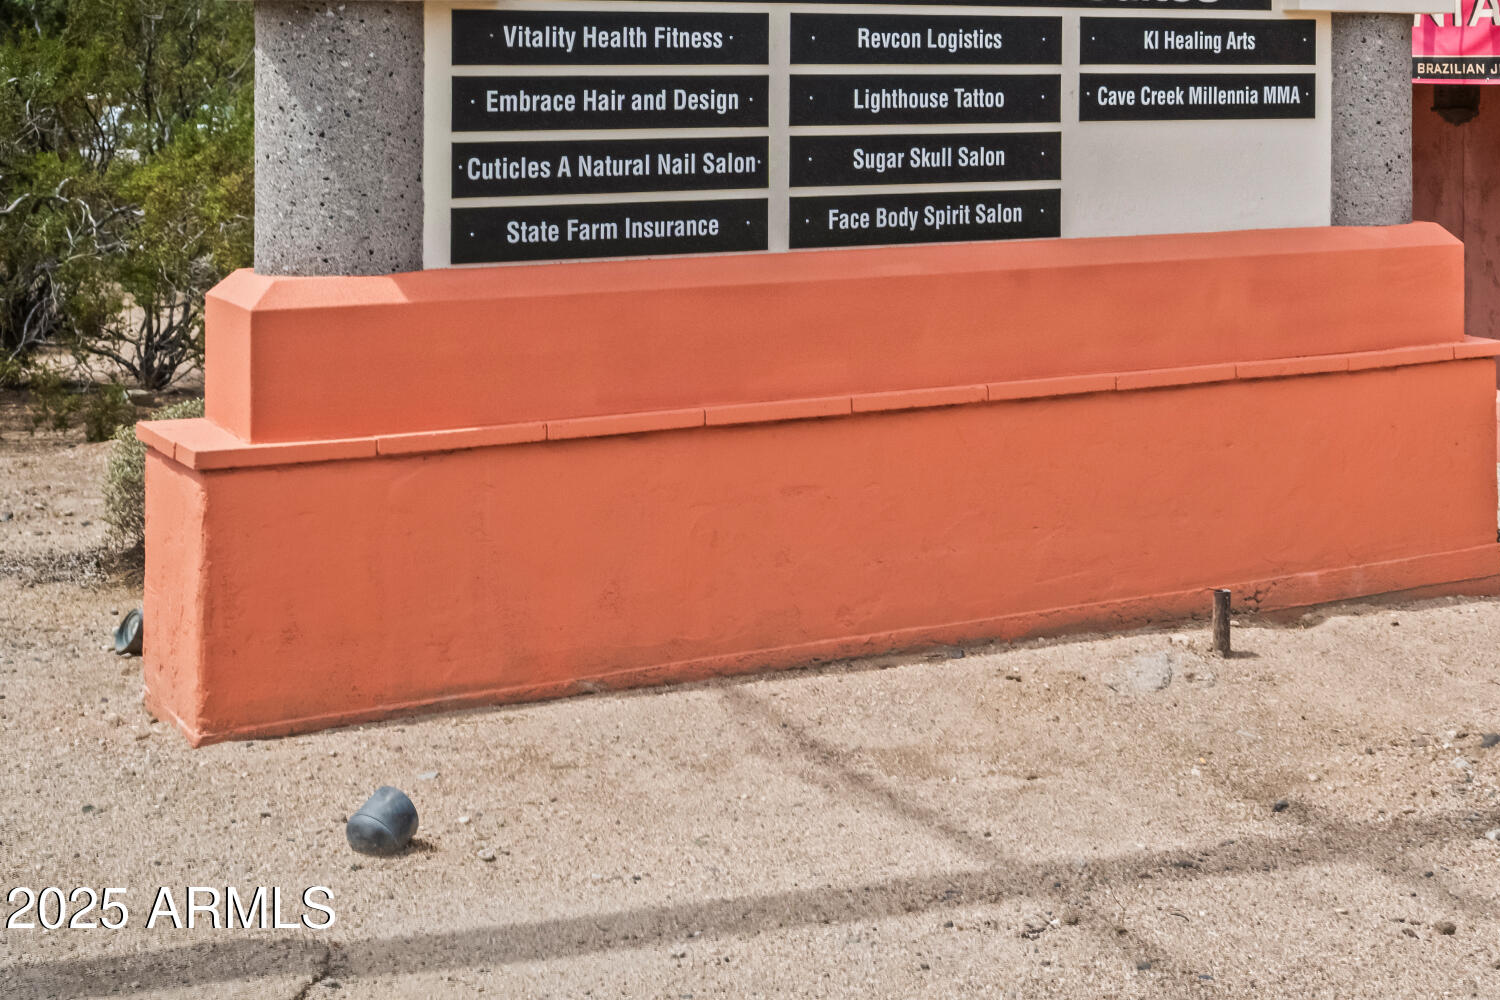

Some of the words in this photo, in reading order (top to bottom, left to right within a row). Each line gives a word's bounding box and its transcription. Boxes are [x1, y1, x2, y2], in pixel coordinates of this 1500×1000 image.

[503, 25, 577, 53] Vitality
[583, 26, 647, 49] Health
[654, 26, 723, 50] Fitness
[857, 27, 921, 49] Revcon
[927, 28, 1002, 54] Logistics
[1164, 30, 1222, 55] Healing
[1225, 31, 1257, 51] Arts
[1417, 62, 1485, 74] BRAZILIAN
[486, 89, 576, 113] Embrace
[583, 89, 626, 111] Hair
[631, 89, 667, 112] and
[673, 88, 739, 116] Design
[853, 88, 949, 114] Lighthouse
[953, 87, 1005, 109] Tattoo
[1097, 86, 1136, 107] Cave
[1140, 85, 1185, 106] Creek
[1188, 85, 1259, 106] Millennia
[1263, 85, 1301, 105] MMA
[467, 156, 551, 182] Cuticles
[557, 155, 572, 178] A
[578, 154, 650, 178] Natural
[657, 152, 696, 176] Nail
[702, 152, 756, 175] Salon
[853, 148, 905, 174] Sugar
[909, 147, 952, 169] Skull
[958, 146, 1005, 168] Salon
[506, 221, 559, 244] State
[567, 219, 618, 242] Farm
[625, 217, 719, 240] Insurance
[828, 209, 870, 231] Face
[876, 206, 919, 232] Body
[923, 204, 971, 231] Spirit
[975, 203, 1023, 225] Salon
